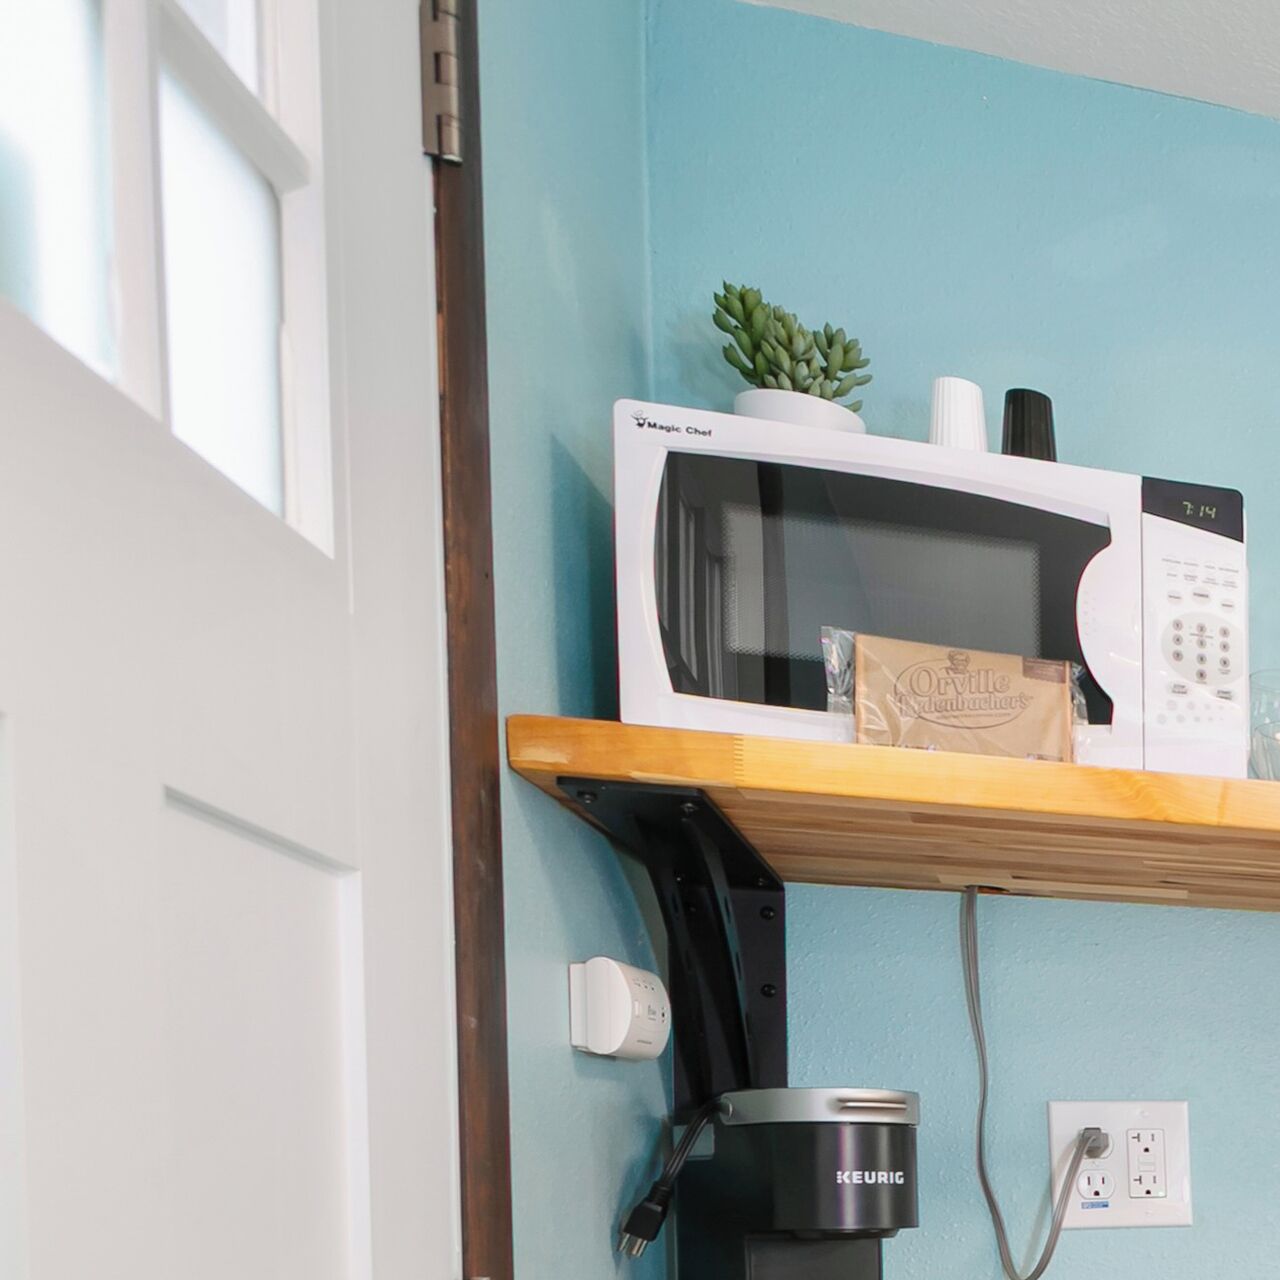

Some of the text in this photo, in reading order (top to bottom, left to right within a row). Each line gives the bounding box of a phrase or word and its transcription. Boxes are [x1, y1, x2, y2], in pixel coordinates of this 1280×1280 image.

[647, 420, 713, 437] Magic Chef
[1182, 501, 1217, 519] 7:14
[909, 665, 1011, 698] Orville
[836, 1170, 905, 1185] KEURIG
